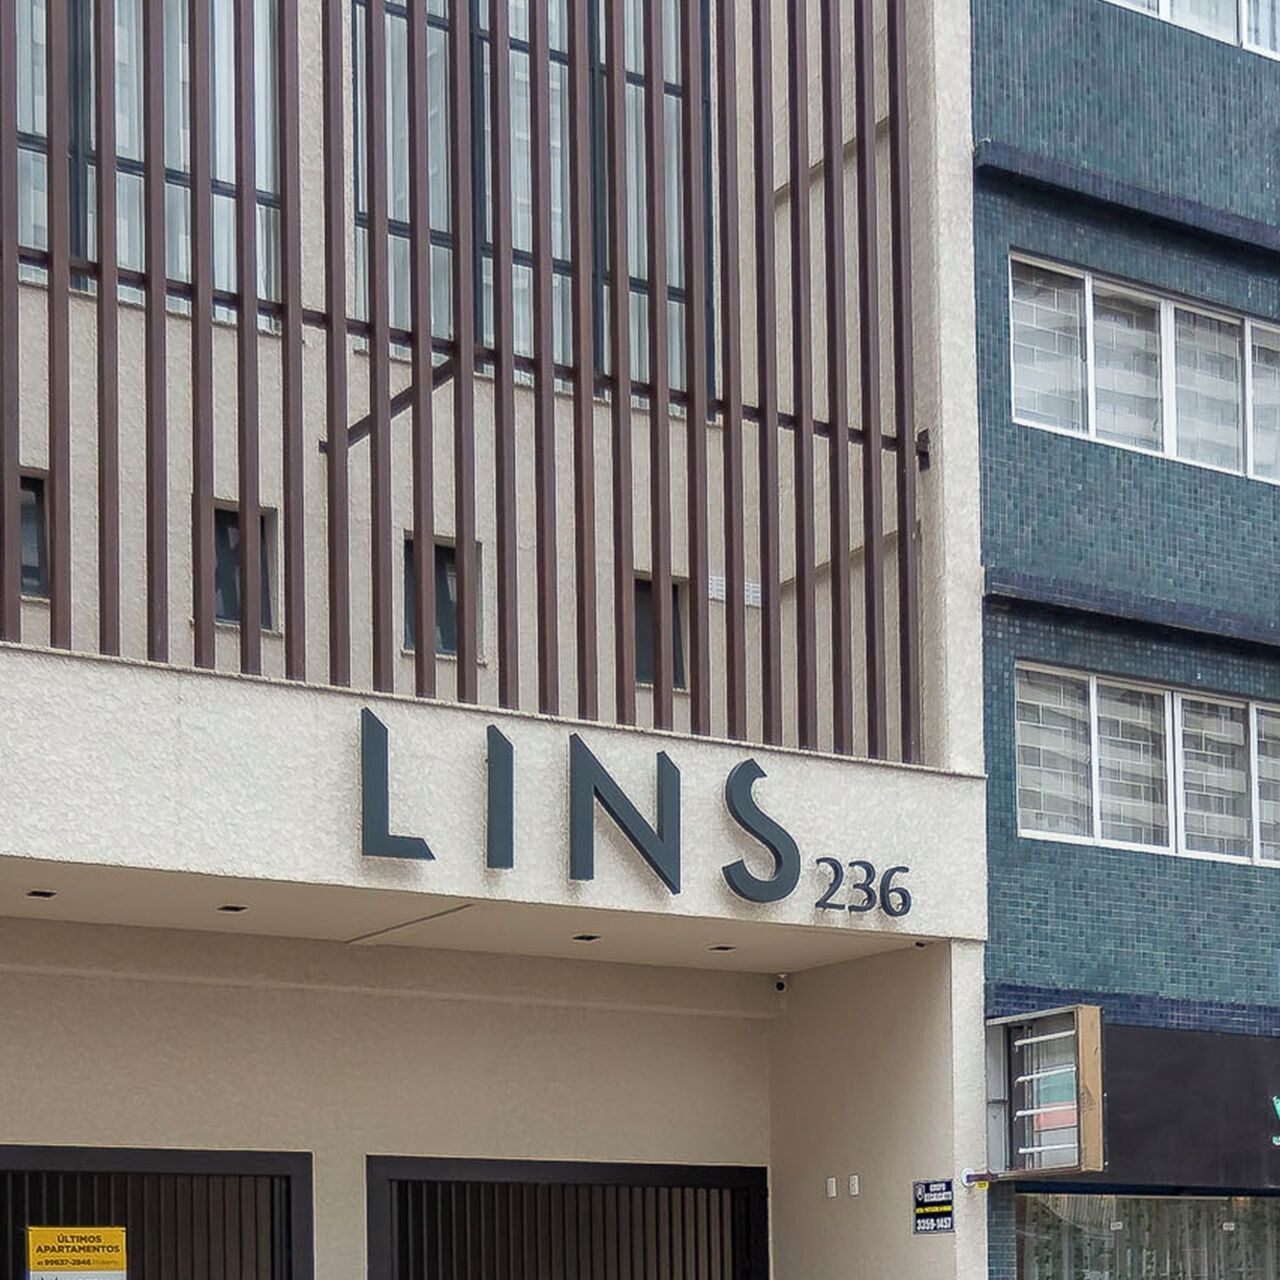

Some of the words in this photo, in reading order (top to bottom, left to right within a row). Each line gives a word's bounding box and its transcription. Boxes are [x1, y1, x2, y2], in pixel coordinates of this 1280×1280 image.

[361, 707, 801, 903] LINS
[815, 857, 912, 917] 236
[36, 1245, 120, 1254] APARTAMENTOS
[57, 1233, 102, 1243] ÚLTIMOS
